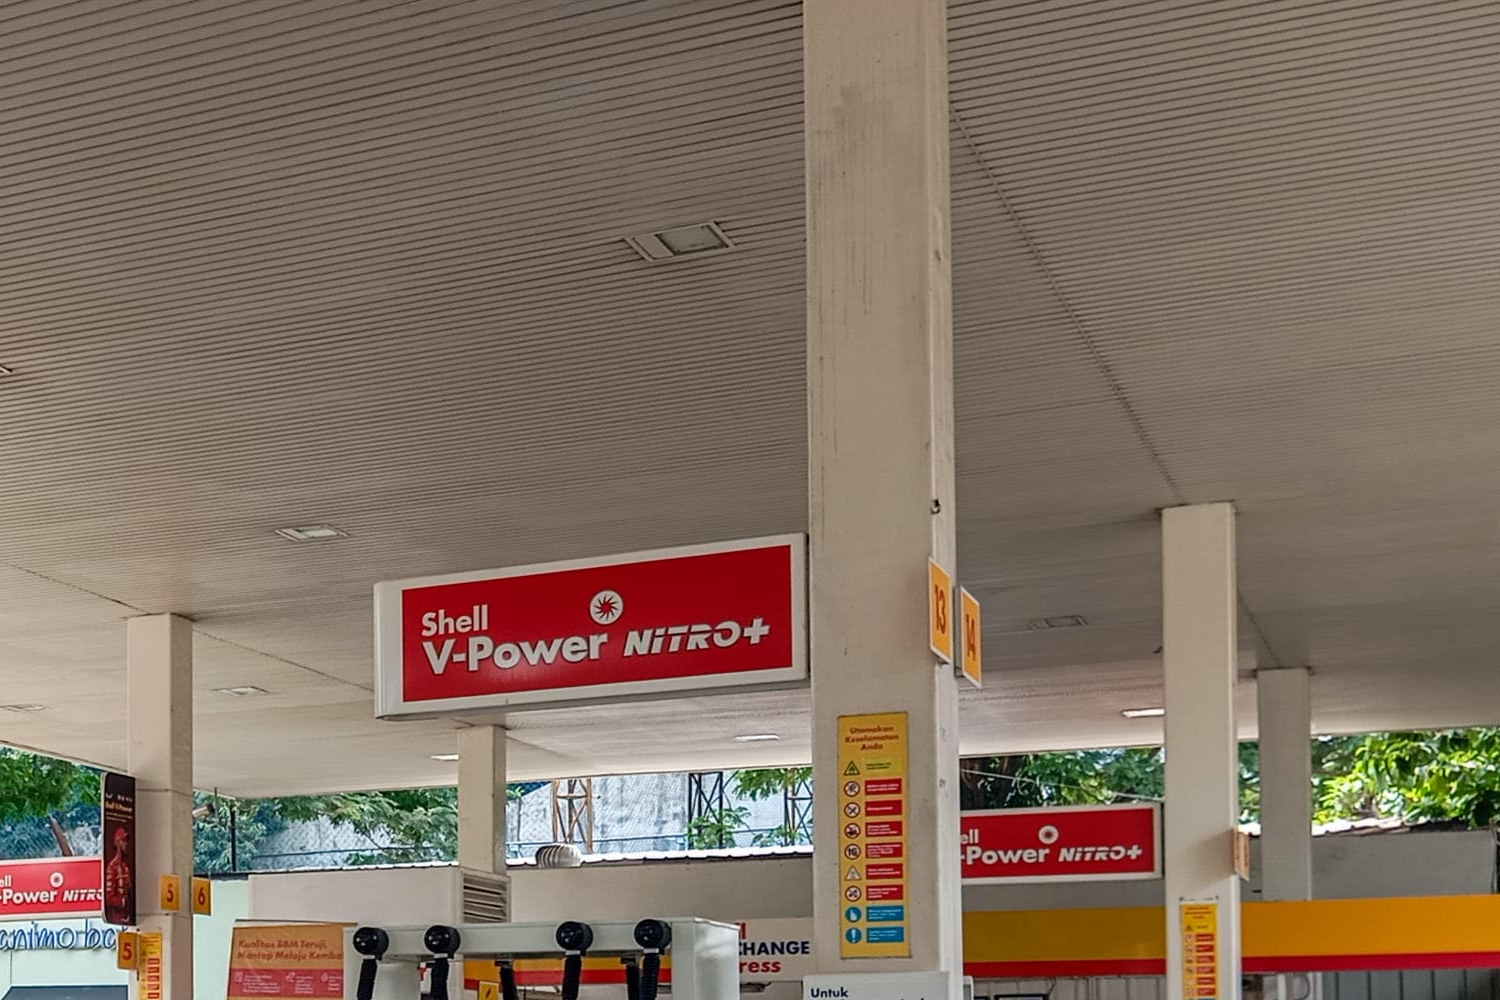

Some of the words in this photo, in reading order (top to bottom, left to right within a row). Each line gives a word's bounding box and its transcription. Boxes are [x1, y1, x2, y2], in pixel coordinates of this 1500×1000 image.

[934, 584, 946, 635] 13
[421, 603, 488, 637] Shell
[965, 613, 976, 662] 14
[422, 631, 609, 675] V-Power
[844, 733, 900, 744] Keselamatan
[861, 742, 884, 751] Anda
[961, 828, 980, 845] ell
[961, 846, 1050, 865] -Power
[166, 883, 174, 903] 5
[197, 887, 206, 906] 6
[121, 942, 133, 960] 5
[239, 939, 275, 948] Kualitas
[739, 940, 810, 956] HANGE
[308, 950, 343, 960] Kemba
[739, 960, 781, 973] ress
[810, 986, 849, 998] Untuk
